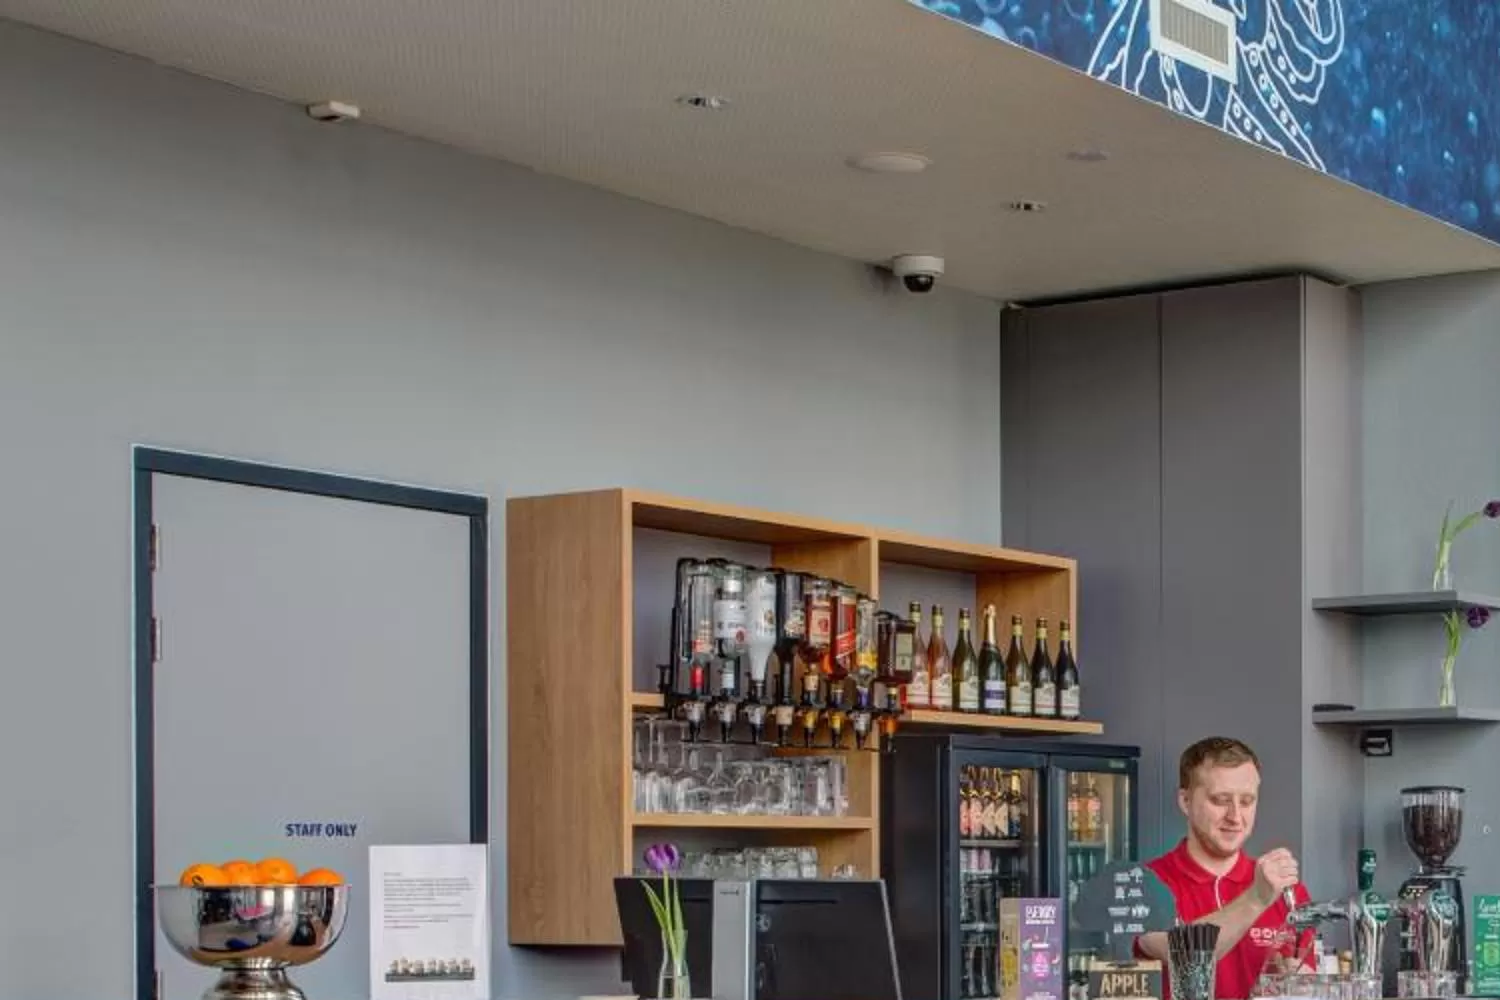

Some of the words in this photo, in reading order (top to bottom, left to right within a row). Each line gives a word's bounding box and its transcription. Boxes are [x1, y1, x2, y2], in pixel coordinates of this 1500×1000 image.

[285, 823, 322, 837] STAFF
[325, 823, 357, 837] ONLY
[1101, 973, 1149, 997] APPLE
